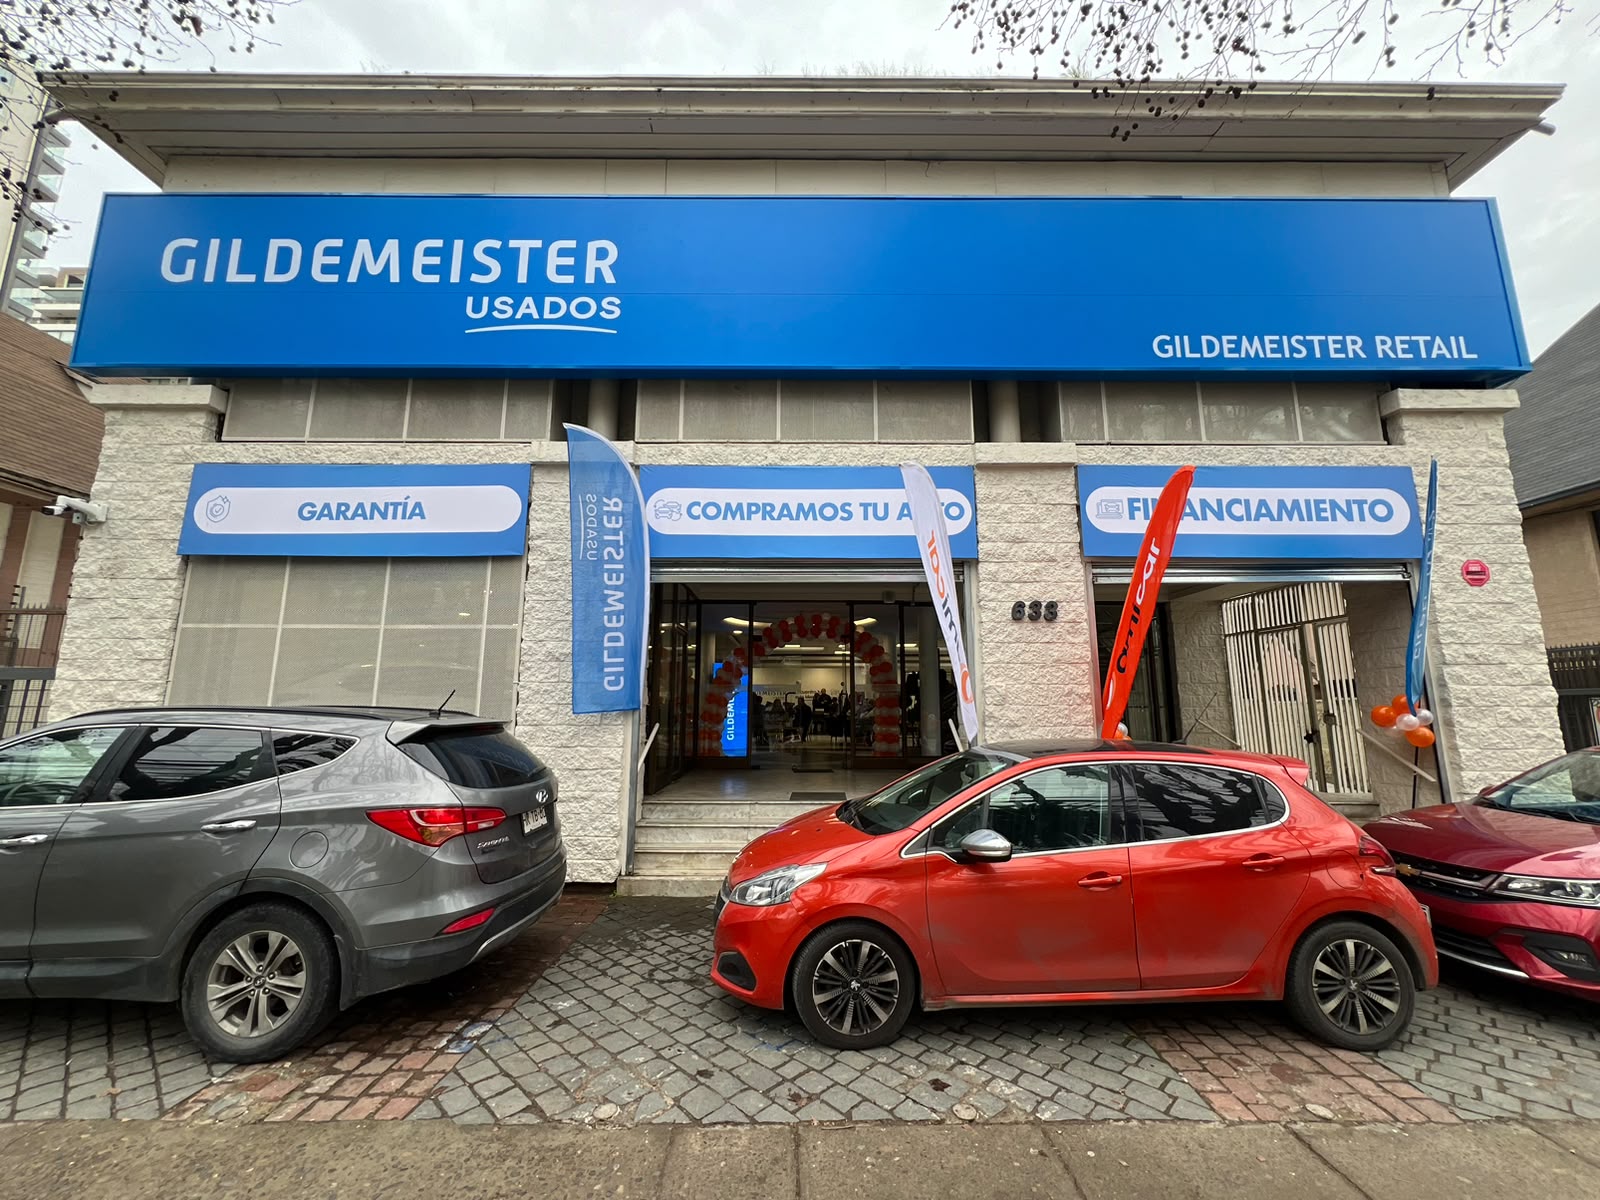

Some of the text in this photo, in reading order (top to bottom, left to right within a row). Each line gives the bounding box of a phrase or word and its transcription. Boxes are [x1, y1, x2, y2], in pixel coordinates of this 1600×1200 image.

[160, 237, 619, 285] GILDEMEISTER
[465, 296, 622, 321] USADOS
[1152, 334, 1478, 360] GILDEMEISTER RETAIL
[297, 495, 427, 522] GARANTÍA
[686, 500, 965, 523] COMPRAMOS TU AO
[1011, 600, 1059, 621] 633
